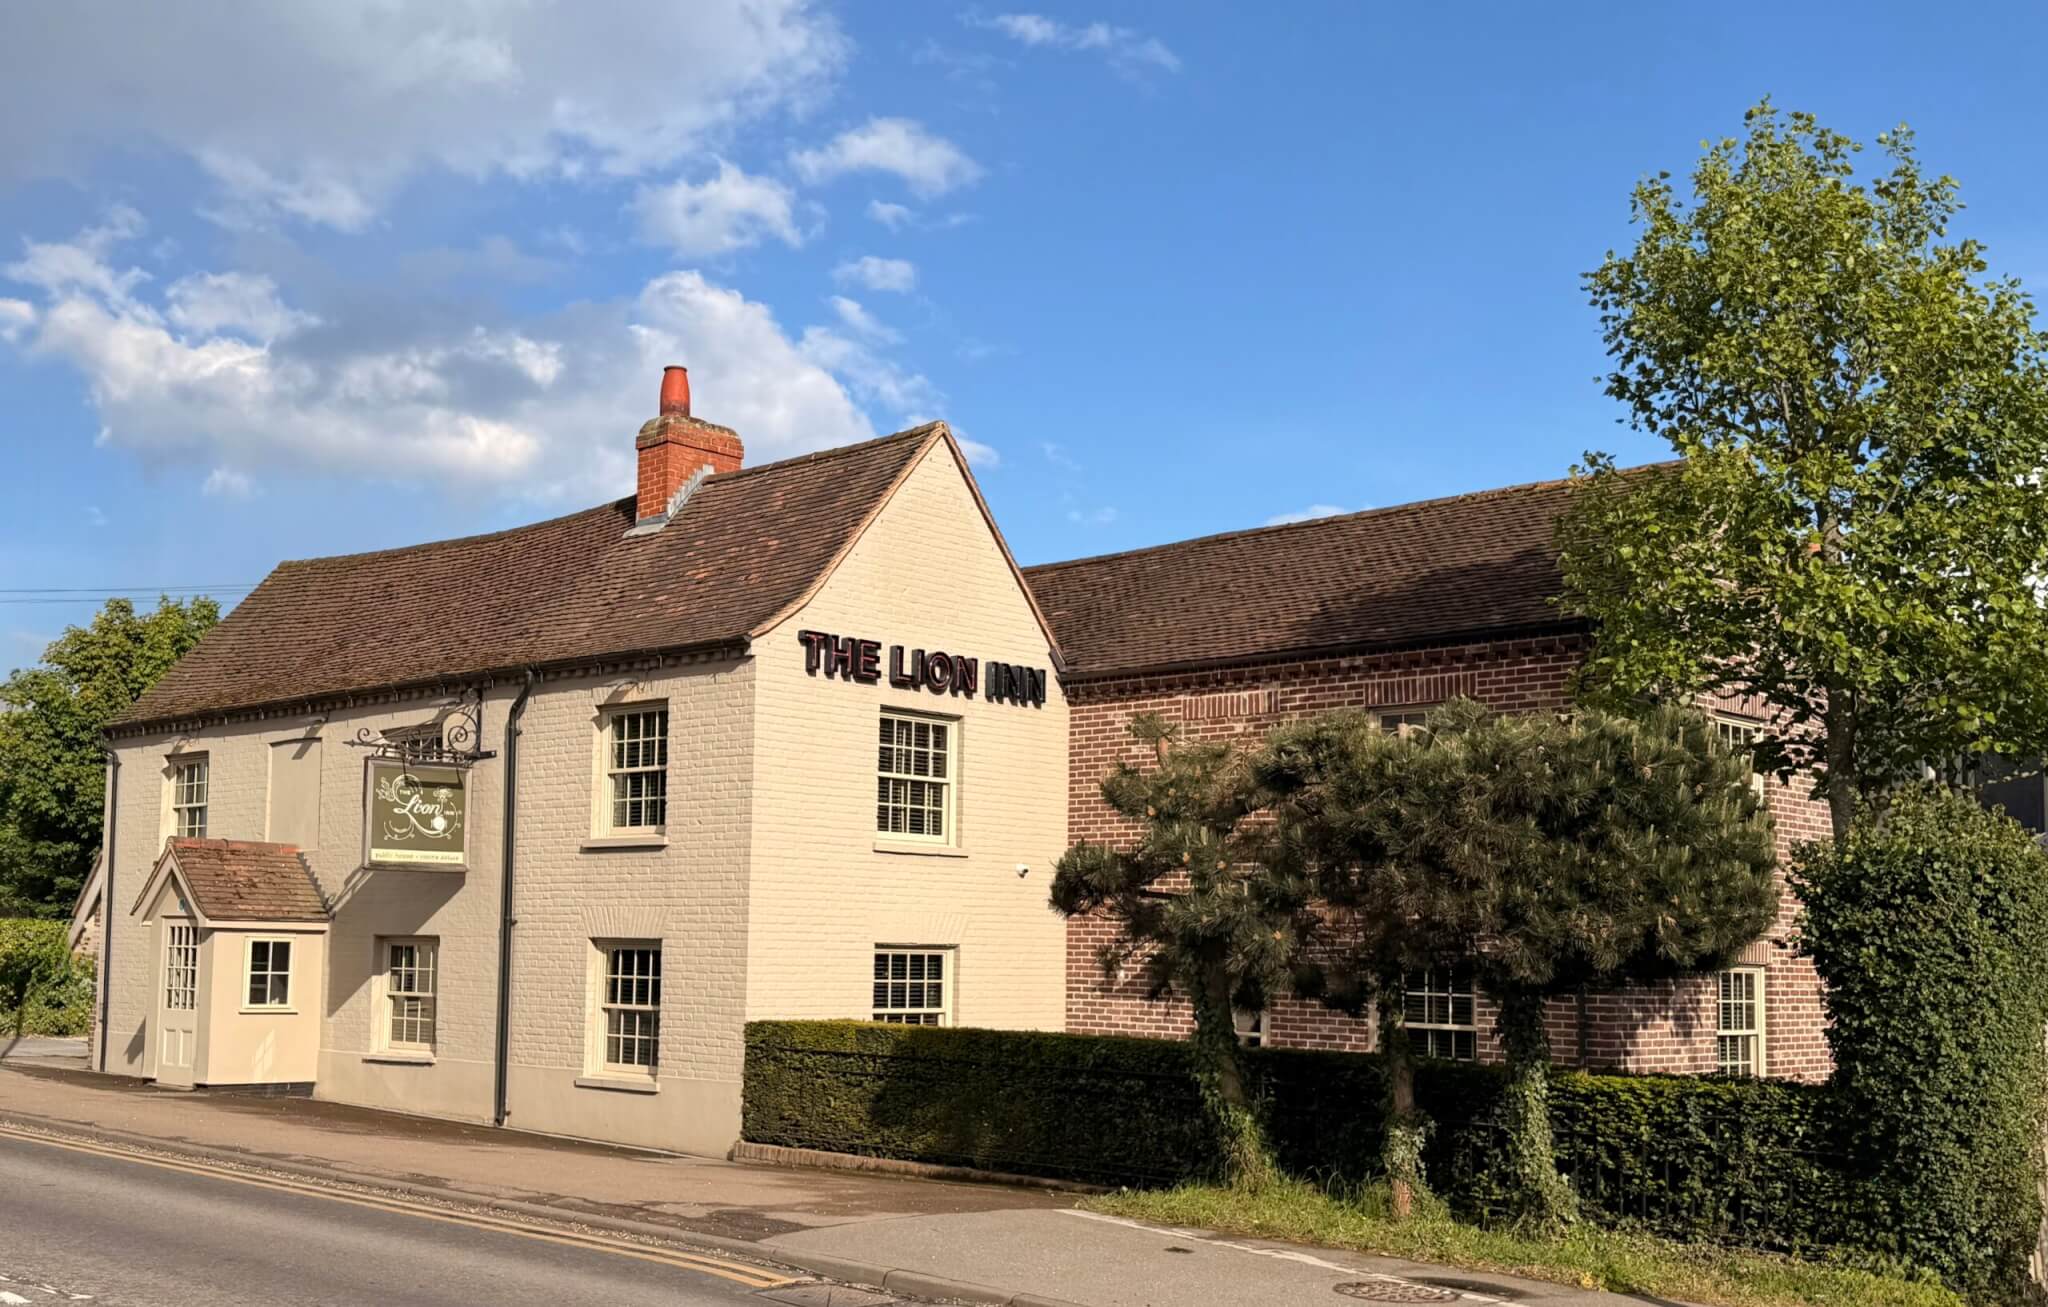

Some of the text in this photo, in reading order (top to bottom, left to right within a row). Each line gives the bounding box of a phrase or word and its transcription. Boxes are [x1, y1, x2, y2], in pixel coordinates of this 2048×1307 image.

[797, 629, 1046, 703] THE LION INN
[393, 794, 441, 816] Lion
